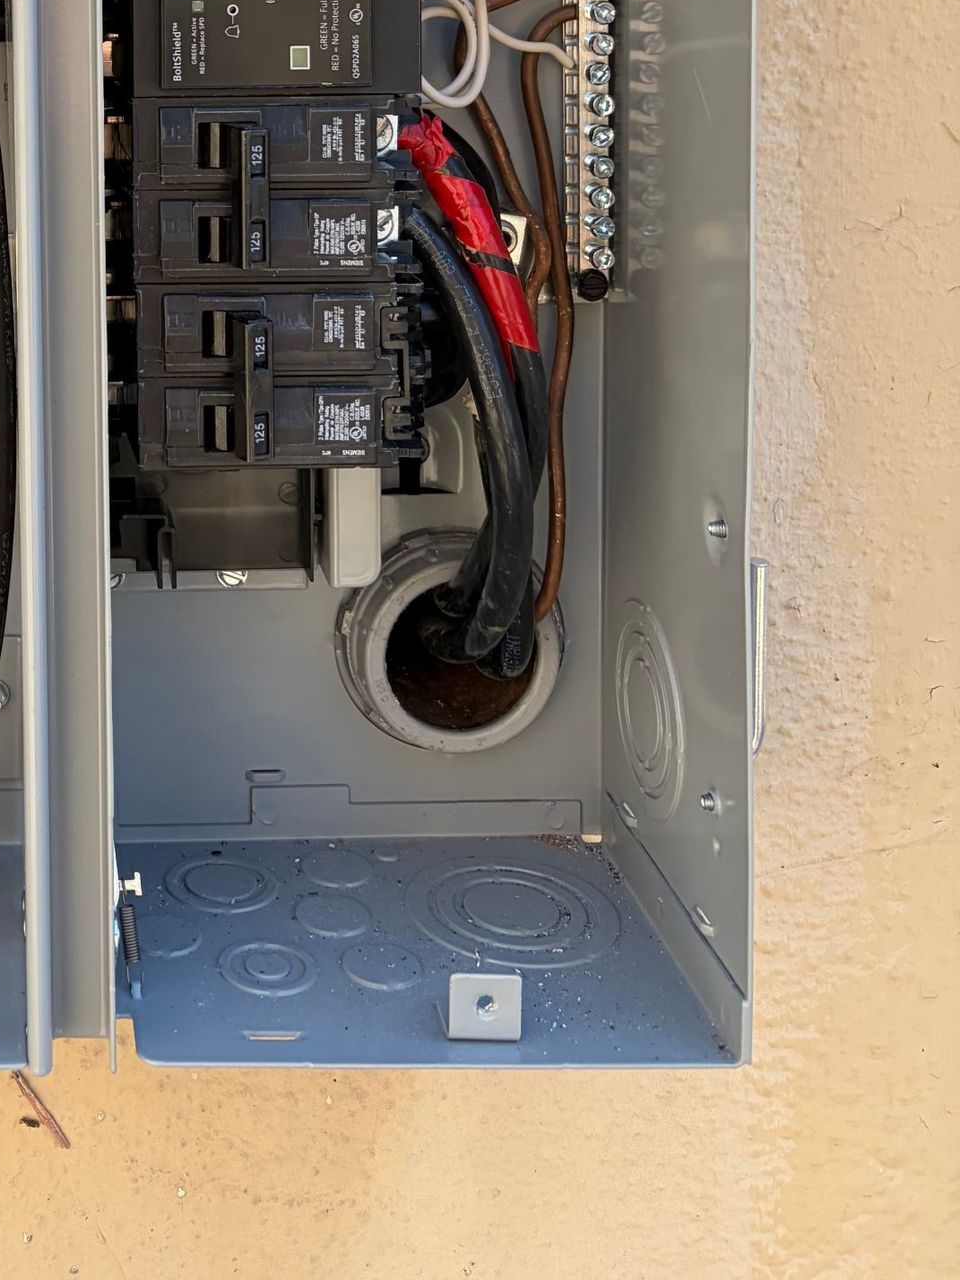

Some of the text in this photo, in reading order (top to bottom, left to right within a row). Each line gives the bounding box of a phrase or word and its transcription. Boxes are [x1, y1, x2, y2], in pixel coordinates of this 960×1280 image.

[320, 22, 328, 50] GREEN
[331, 33, 339, 45] No
[251, 145, 263, 166] 125
[250, 231, 261, 253] 125
[254, 336, 266, 358] 125
[254, 423, 265, 444] 125
